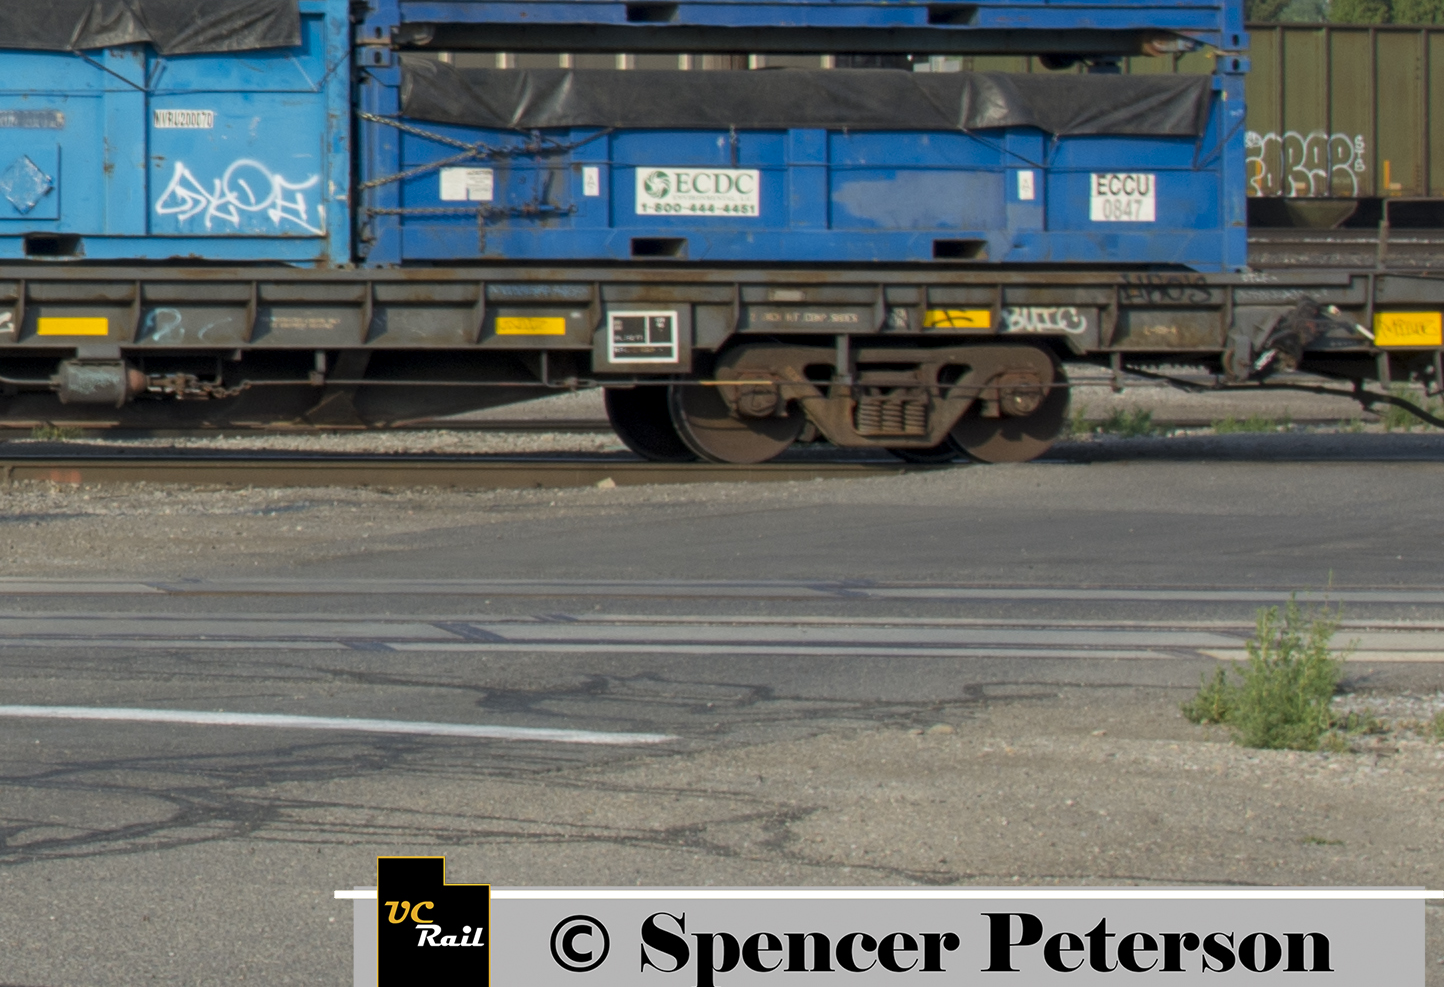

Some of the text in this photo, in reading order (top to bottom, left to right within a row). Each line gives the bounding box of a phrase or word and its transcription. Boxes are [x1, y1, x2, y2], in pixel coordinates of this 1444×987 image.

[674, 172, 754, 194] ECDC
[1096, 174, 1150, 196] ECCU
[1103, 199, 1144, 221] 0847
